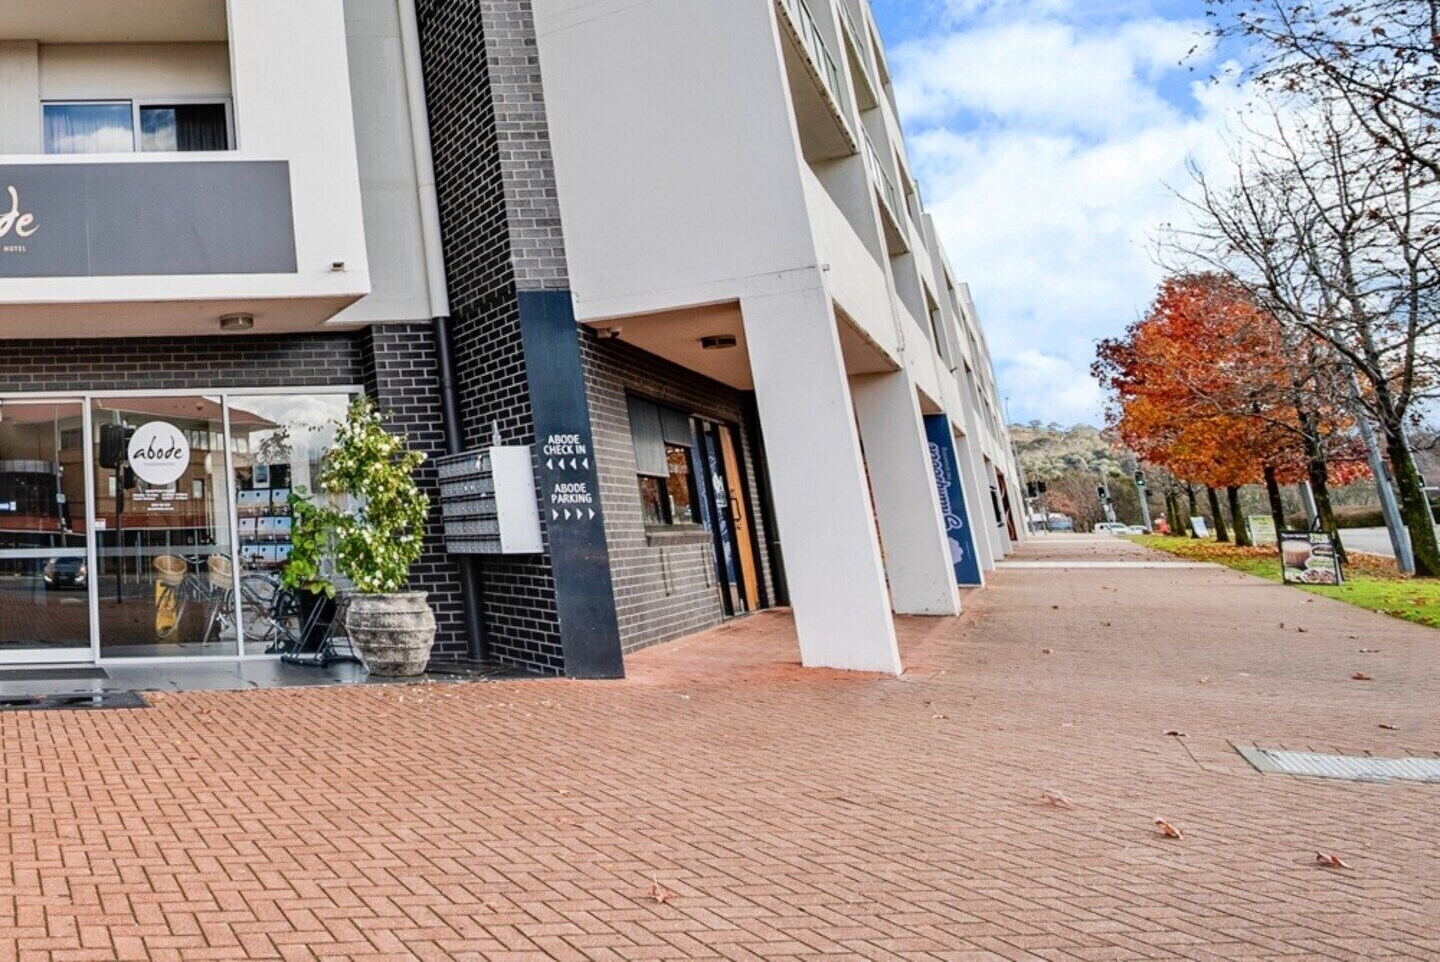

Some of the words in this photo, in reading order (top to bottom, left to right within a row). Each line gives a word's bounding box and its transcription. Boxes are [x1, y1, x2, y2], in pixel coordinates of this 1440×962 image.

[3, 244, 26, 252] HOTEL
[548, 434, 580, 444] ABODE
[133, 435, 183, 459] abode
[543, 444, 574, 455] CHECK
[575, 444, 587, 454] IN
[554, 483, 587, 493] ABODE
[551, 493, 593, 504] PARKING
